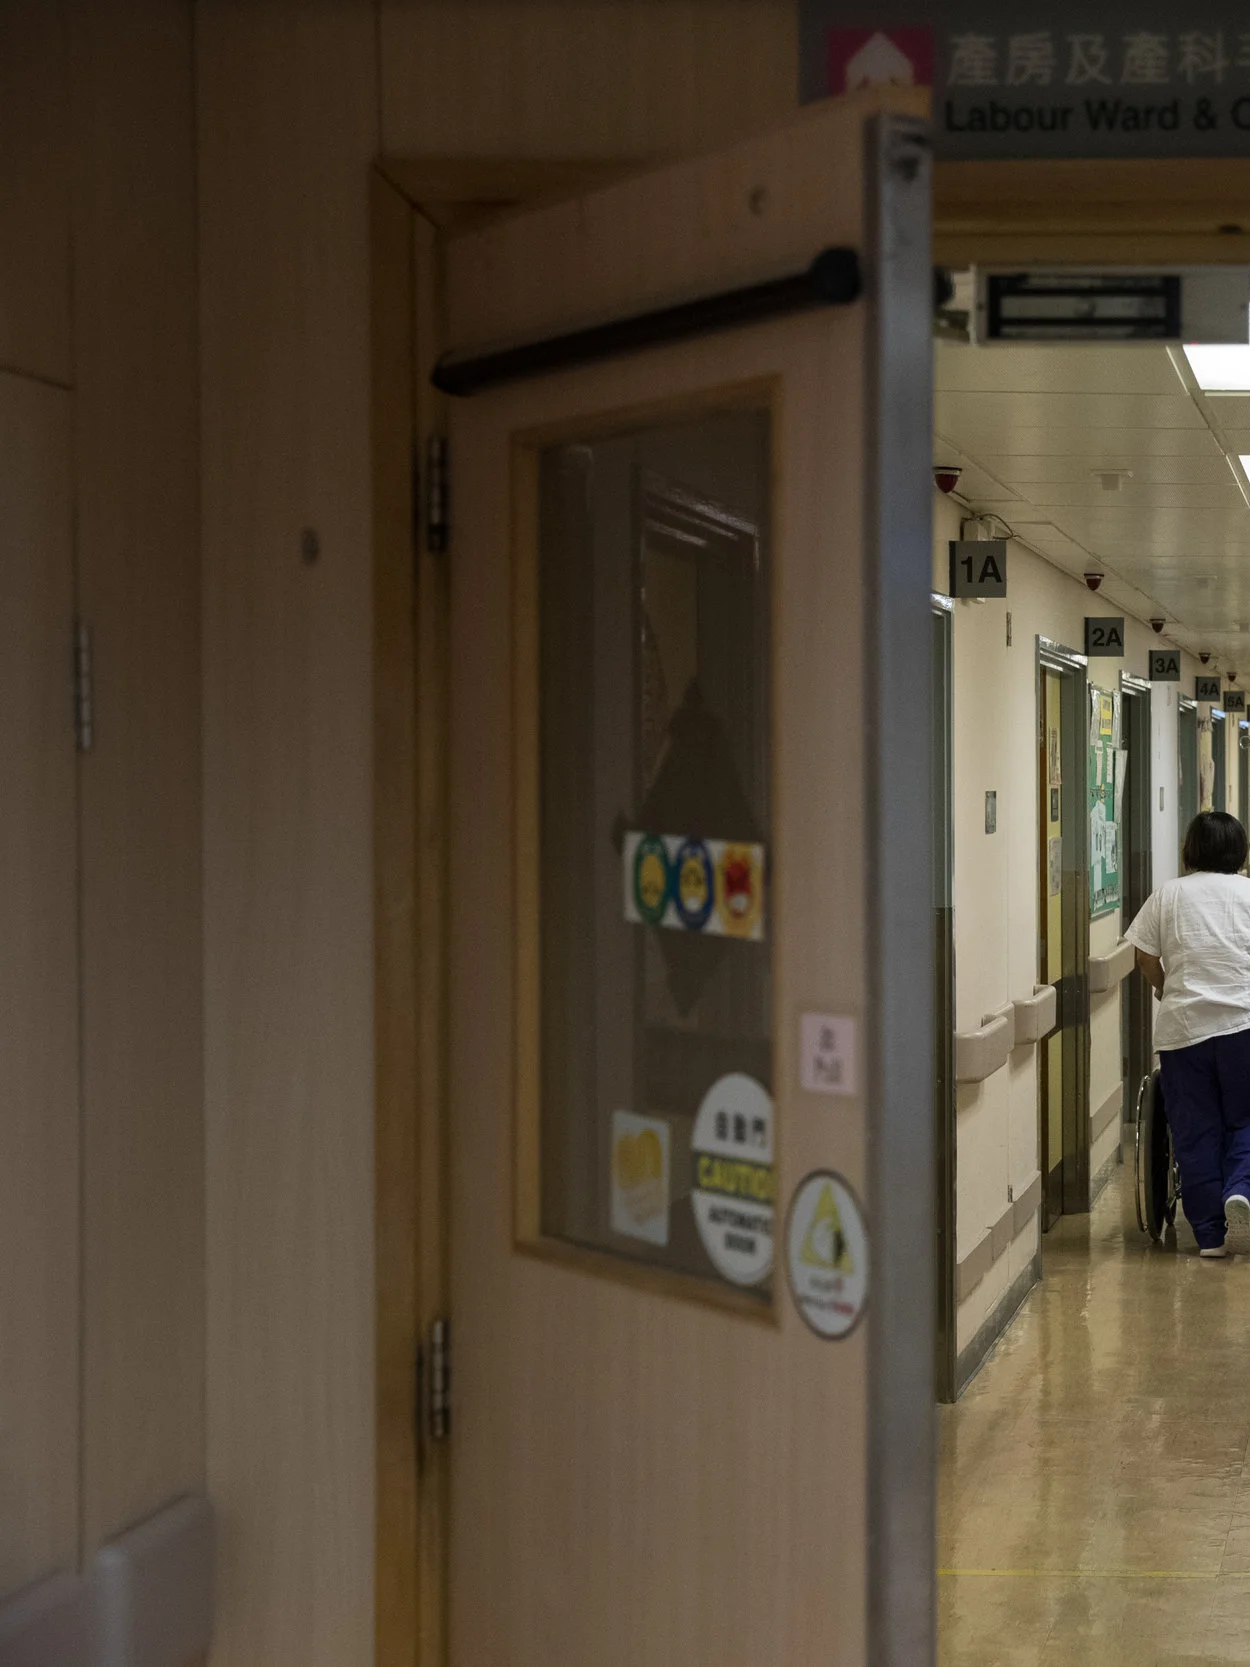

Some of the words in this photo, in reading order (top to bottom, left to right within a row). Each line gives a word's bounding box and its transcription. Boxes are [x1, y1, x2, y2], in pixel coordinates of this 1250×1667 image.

[945, 98, 1072, 133] Labour
[1084, 98, 1179, 132] Ward
[1193, 98, 1217, 131] &
[960, 555, 1003, 584] 1A
[1091, 627, 1123, 647] 2A
[1154, 656, 1179, 675] 3A
[1199, 682, 1219, 697] 4A
